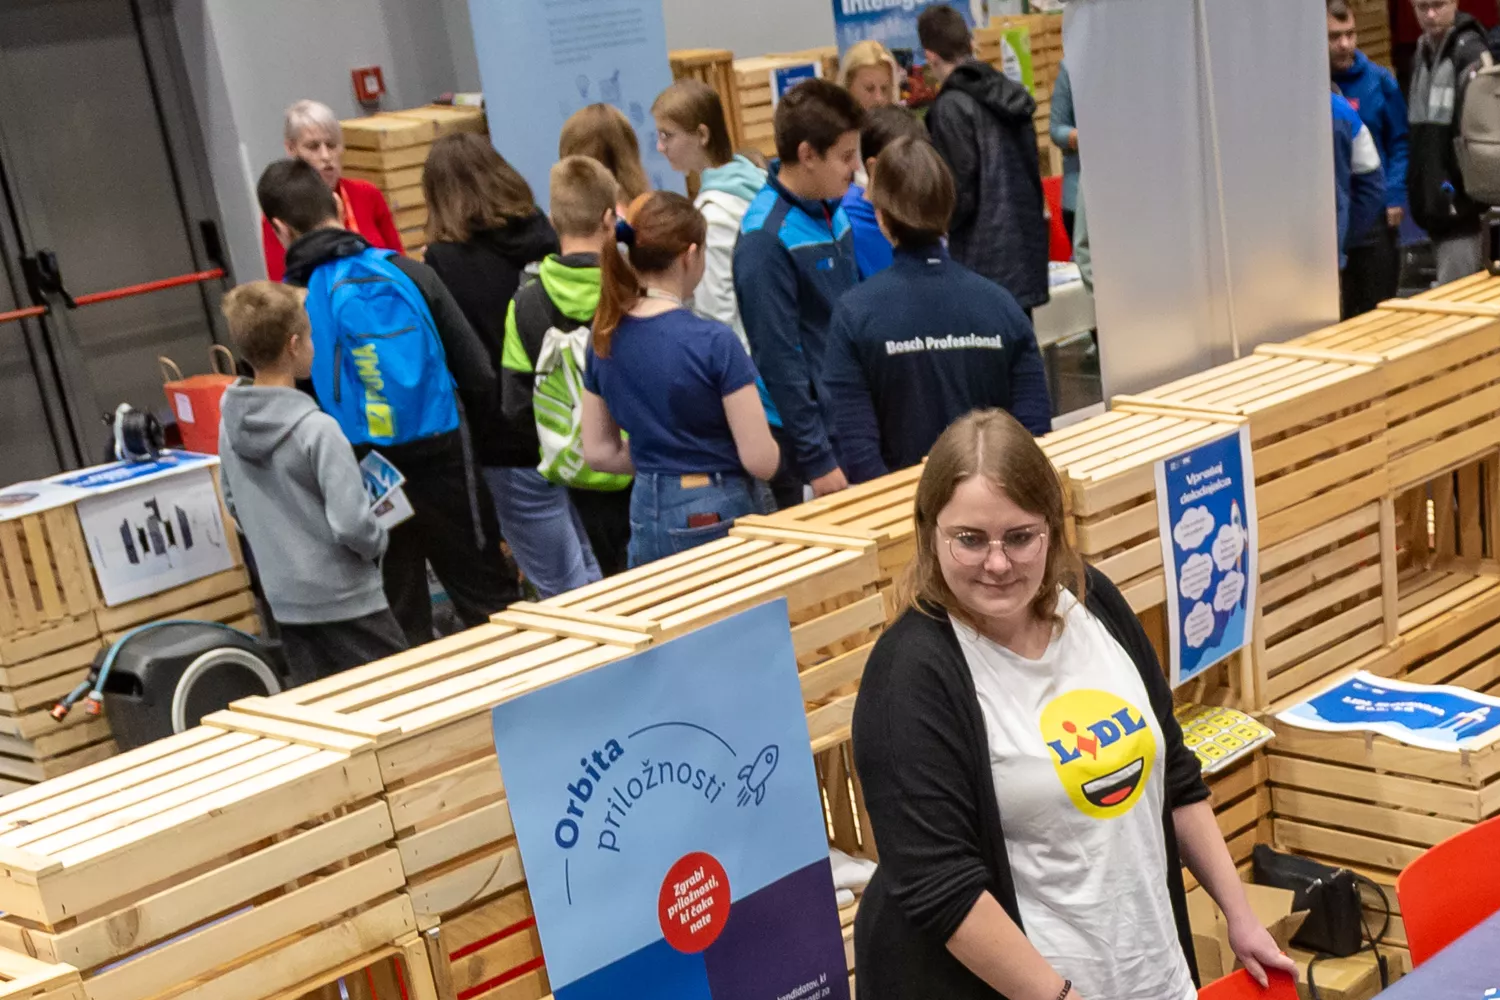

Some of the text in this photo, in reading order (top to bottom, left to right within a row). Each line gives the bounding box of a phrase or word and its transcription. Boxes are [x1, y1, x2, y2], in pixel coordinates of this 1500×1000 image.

[885, 333, 1003, 355] Bosch Professional
[555, 738, 625, 849] Orbita
[597, 758, 726, 853] priložnosti
[673, 865, 705, 897] Zgrabi
[667, 874, 719, 920] priložnosti,
[680, 896, 714, 925] ki čaka
[689, 913, 711, 934] nate
[821, 986, 831, 997] za
